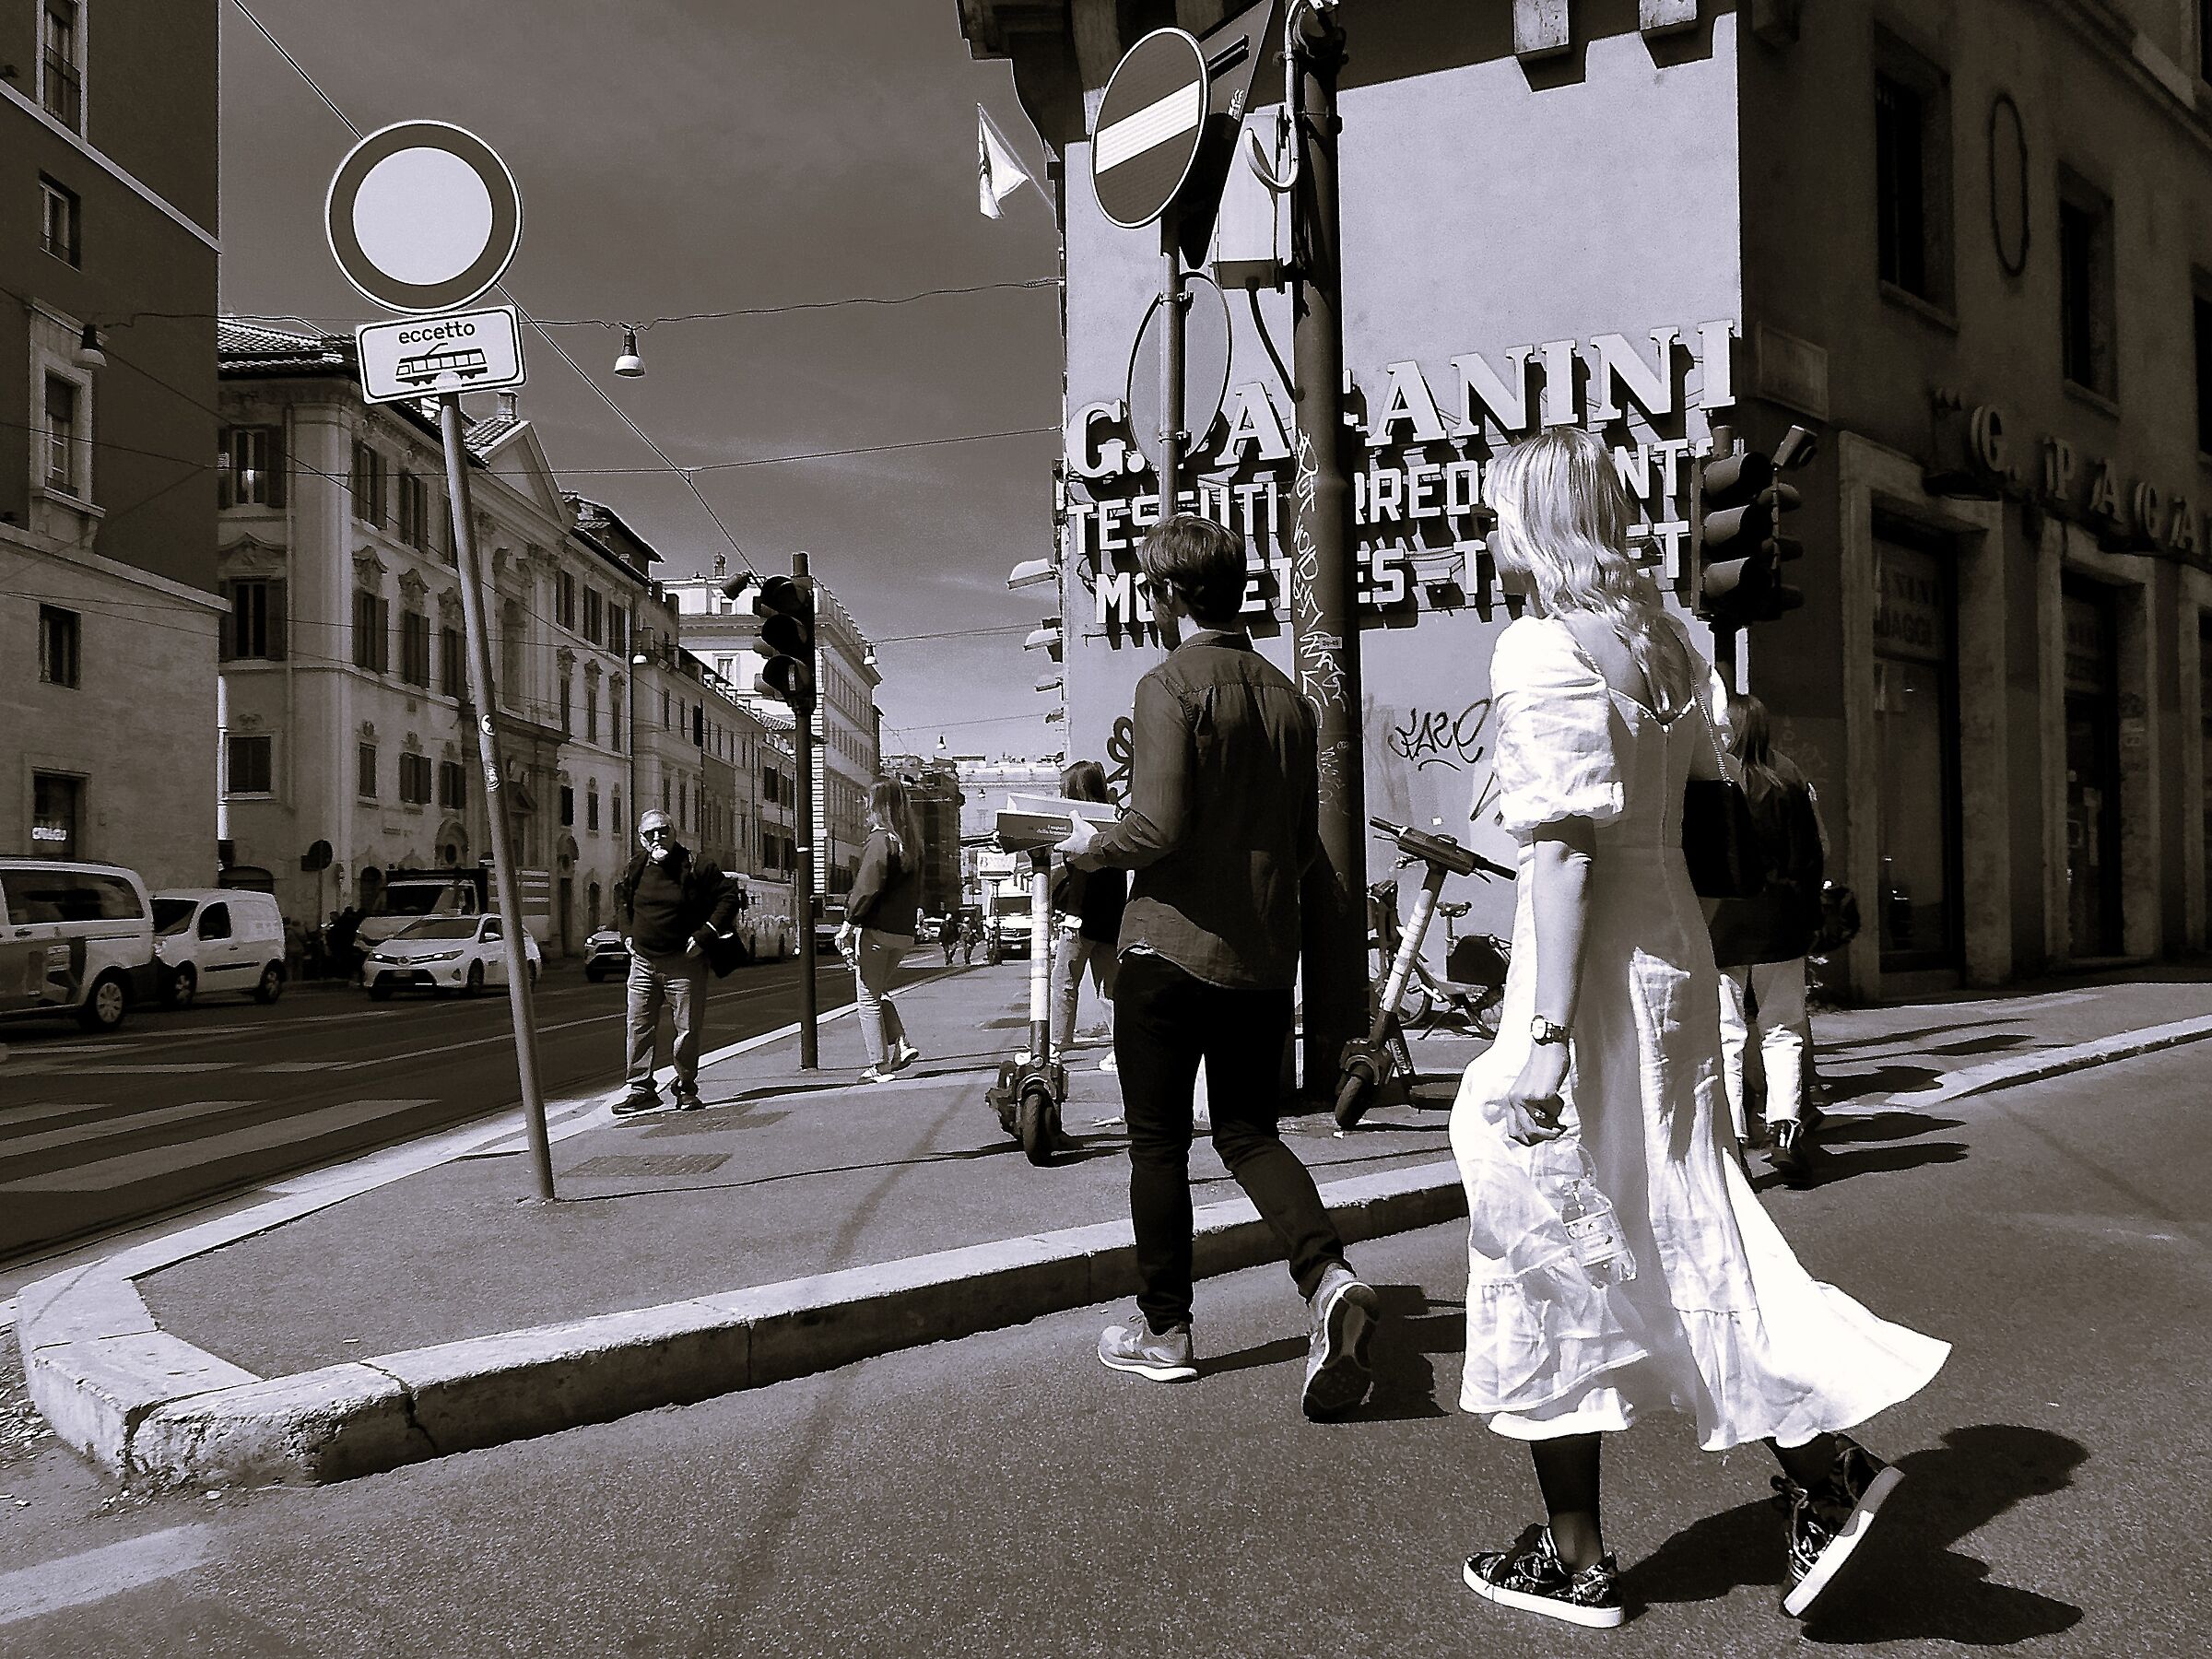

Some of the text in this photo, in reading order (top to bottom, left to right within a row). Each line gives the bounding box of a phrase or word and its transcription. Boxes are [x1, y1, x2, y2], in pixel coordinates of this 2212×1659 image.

[398, 321, 476, 345] eccetto
[1065, 401, 1146, 477] G.
[1154, 318, 1736, 468] AANINI
[2042, 435, 2212, 556] PAGA
